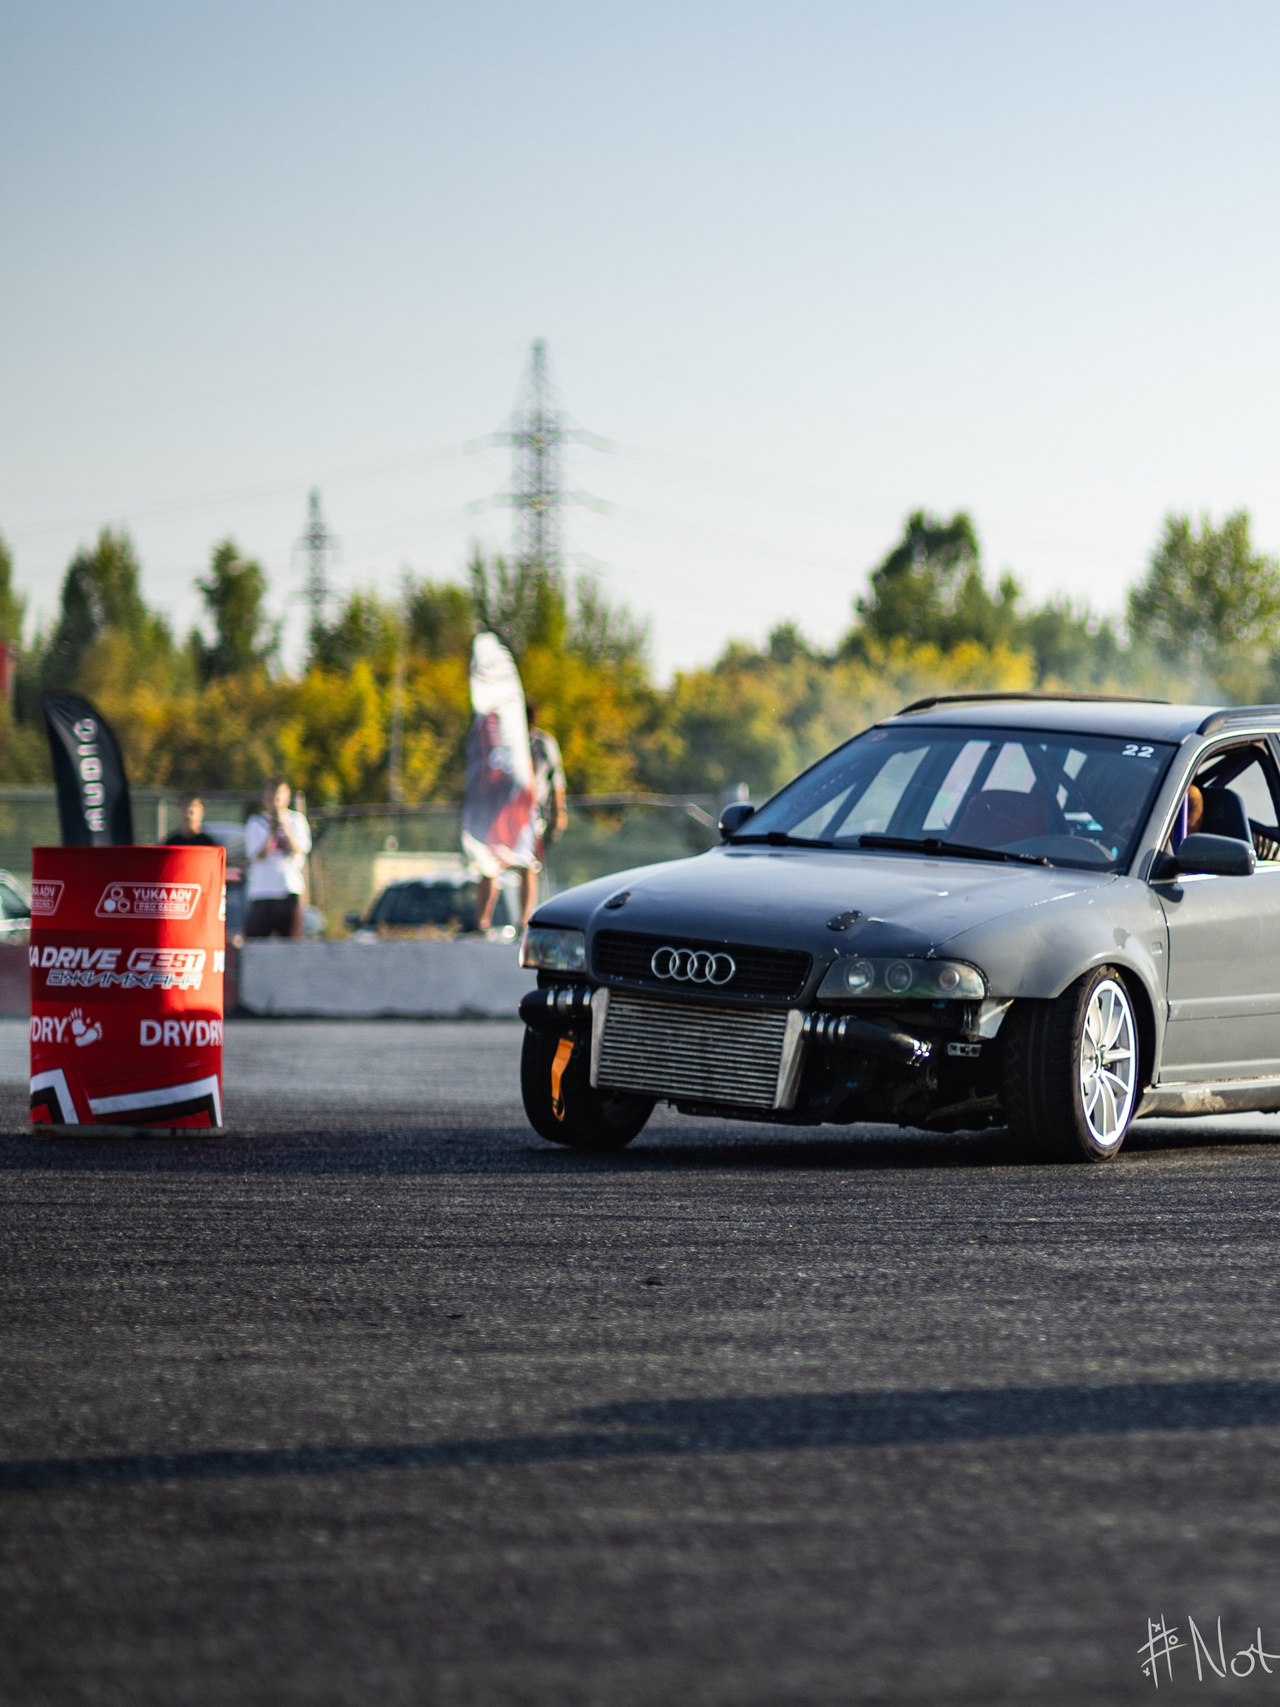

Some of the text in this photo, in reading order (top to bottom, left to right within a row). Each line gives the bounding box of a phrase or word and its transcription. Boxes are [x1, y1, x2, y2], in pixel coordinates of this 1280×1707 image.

[1122, 744, 1155, 758] 22
[133, 888, 192, 901] YUKA ADV
[40, 945, 122, 969] DRIVE
[130, 950, 205, 971] FEST
